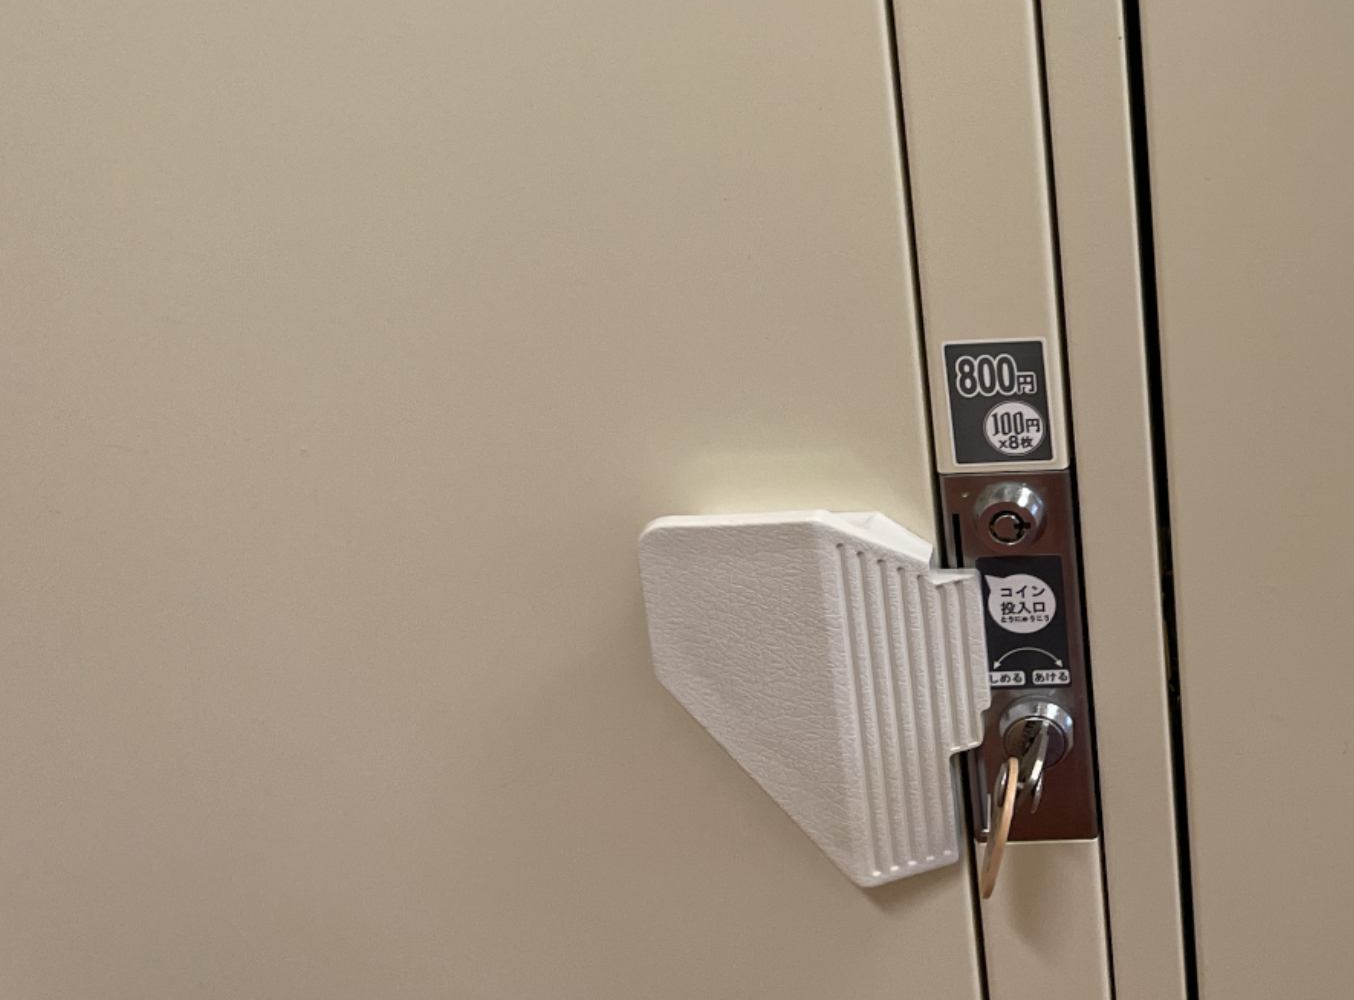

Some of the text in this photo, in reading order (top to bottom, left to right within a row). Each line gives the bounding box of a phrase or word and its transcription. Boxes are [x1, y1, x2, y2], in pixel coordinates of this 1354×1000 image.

[955, 353, 1037, 398] 800円
[991, 411, 1041, 436] 100円
[1000, 585, 1046, 599] コイン
[1000, 601, 1046, 616] 投入口
[1034, 672, 1068, 683] あける
